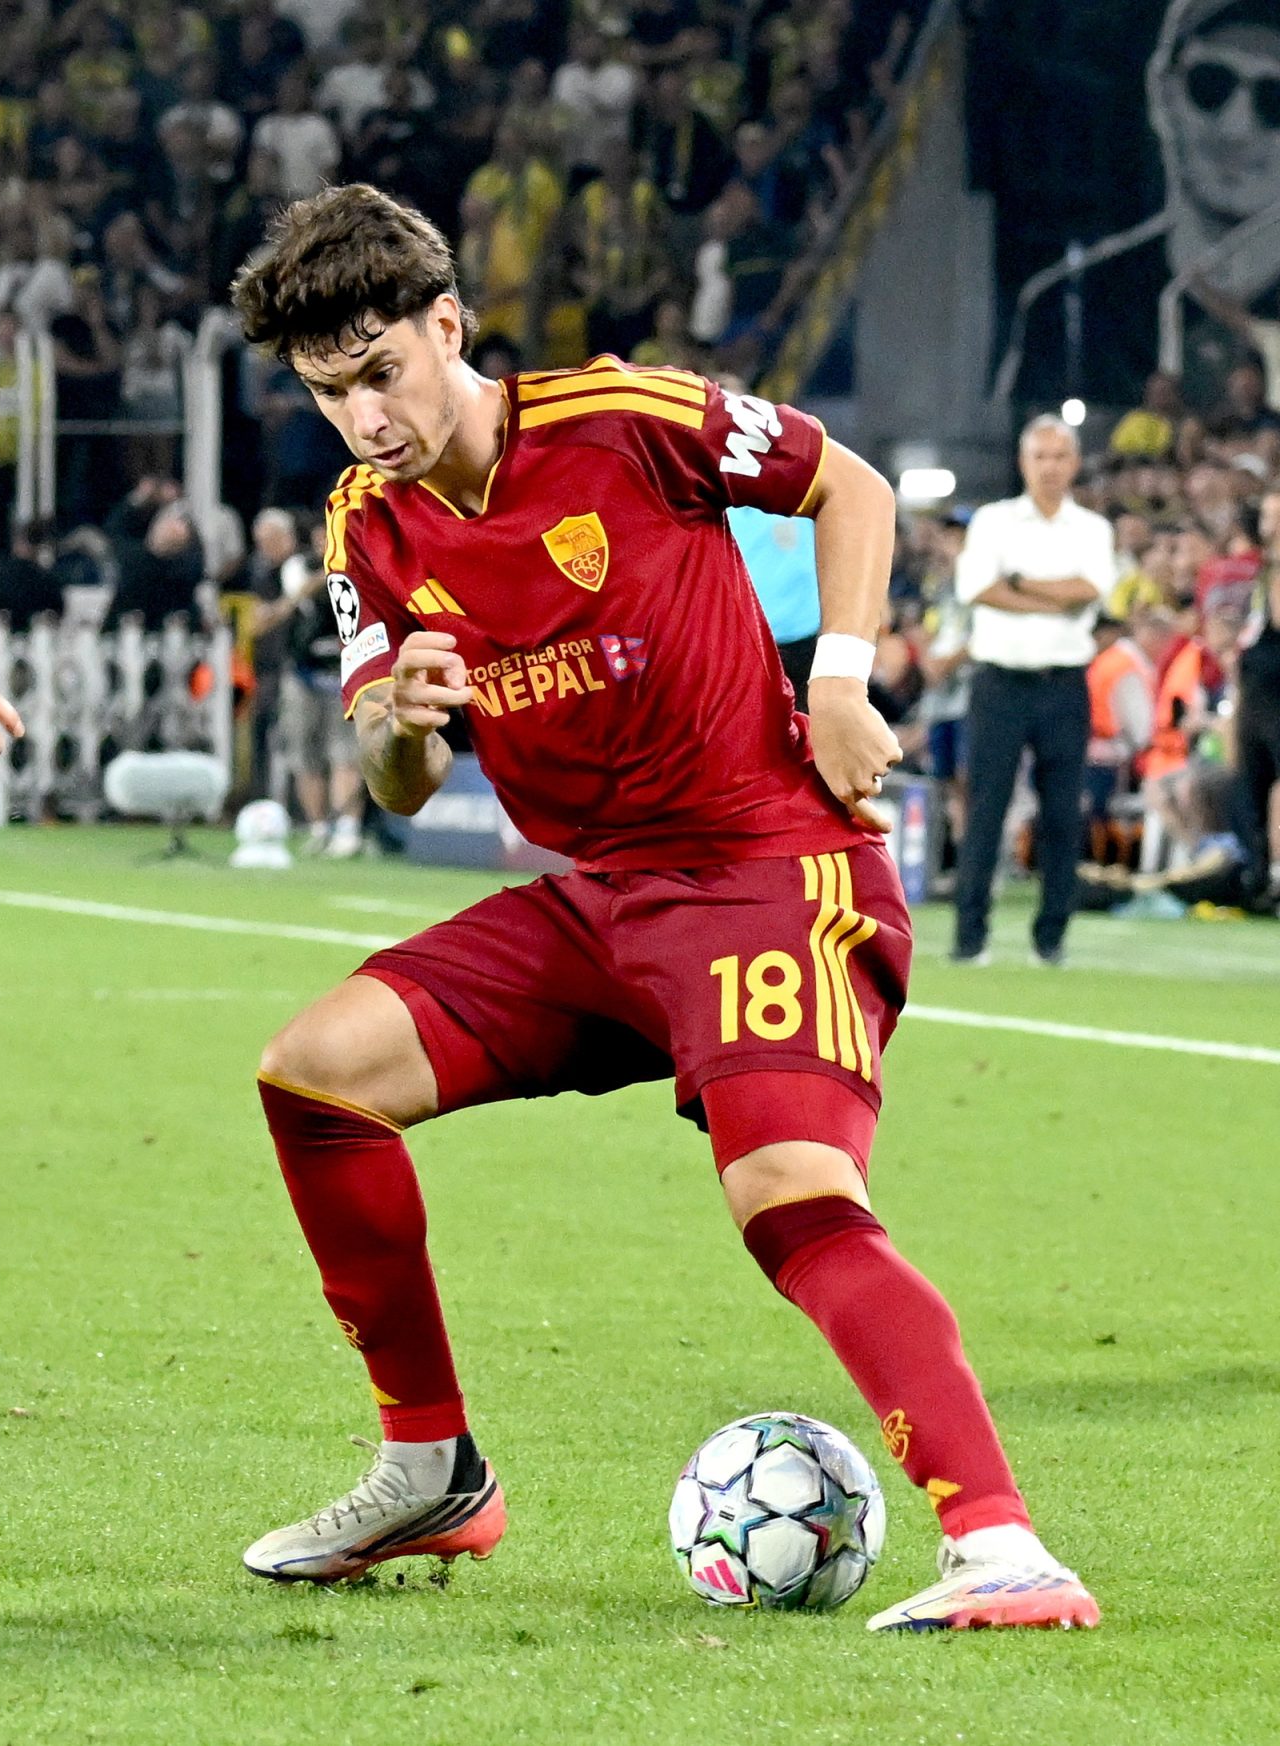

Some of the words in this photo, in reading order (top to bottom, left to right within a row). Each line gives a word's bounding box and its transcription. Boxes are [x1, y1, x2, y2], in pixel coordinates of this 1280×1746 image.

[465, 645, 558, 685] TOGETHER
[558, 638, 595, 660] FOR
[472, 656, 607, 718] NEPAL
[709, 950, 803, 1044] 18
